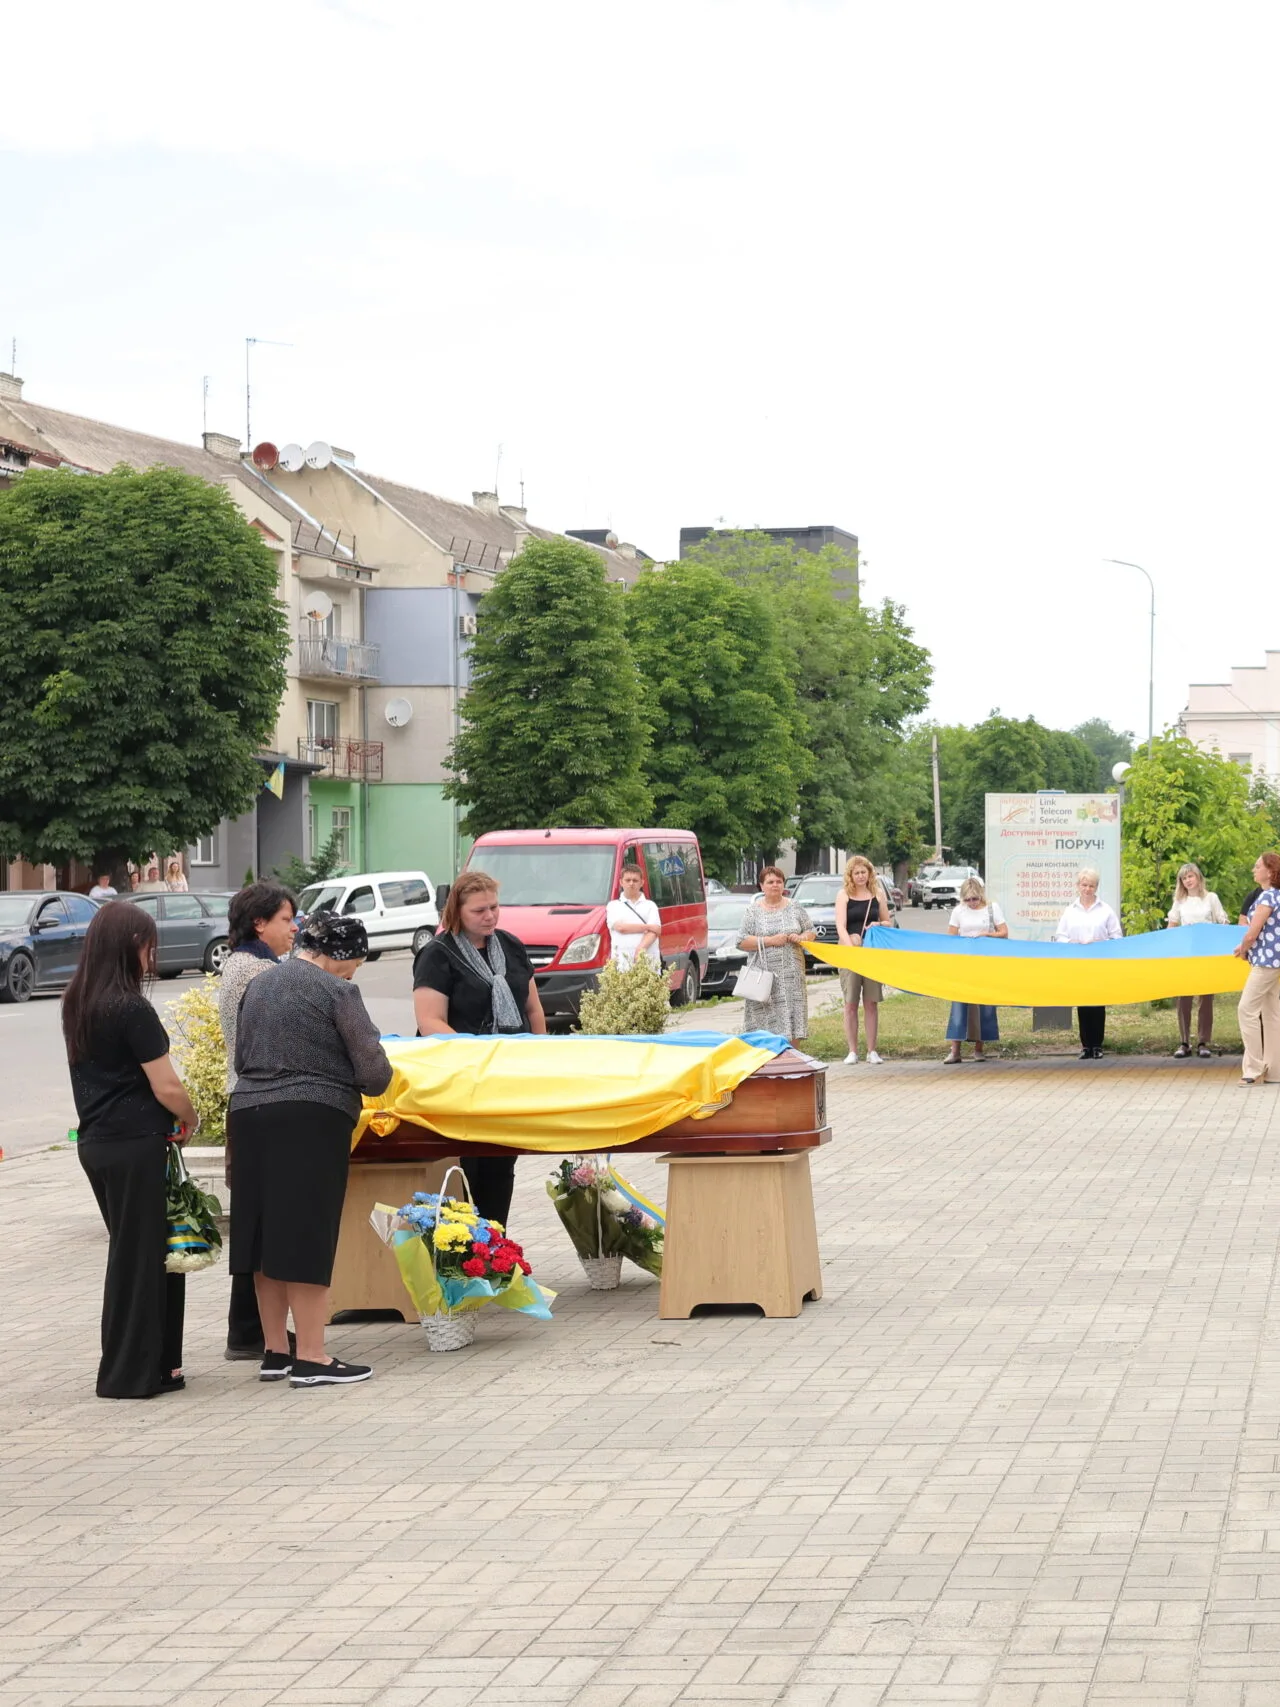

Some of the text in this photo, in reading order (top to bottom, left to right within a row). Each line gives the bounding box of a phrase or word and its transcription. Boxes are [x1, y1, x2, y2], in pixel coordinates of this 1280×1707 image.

[1039, 798, 1057, 806] Link
[1039, 807, 1073, 815] Telecom
[1039, 816, 1069, 824] Service
[1055, 839, 1105, 850] ПОРУЧ!
